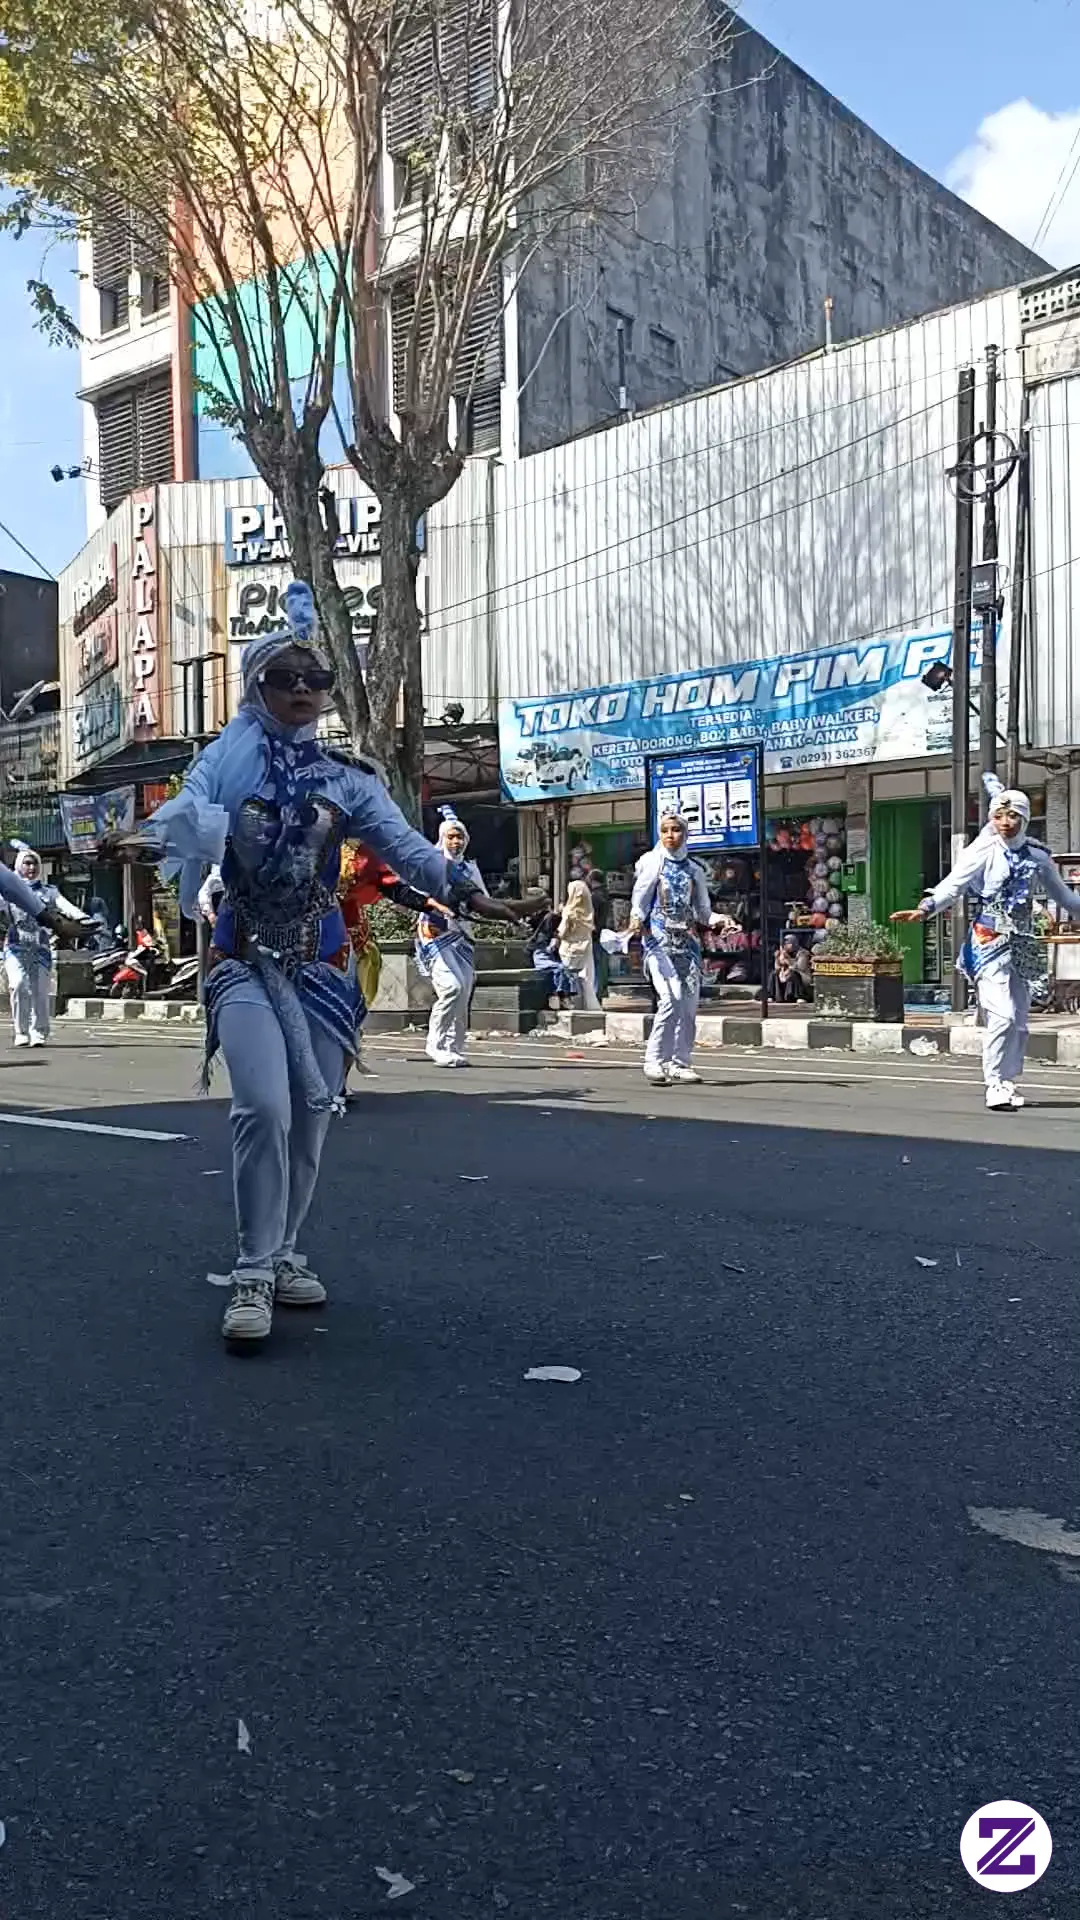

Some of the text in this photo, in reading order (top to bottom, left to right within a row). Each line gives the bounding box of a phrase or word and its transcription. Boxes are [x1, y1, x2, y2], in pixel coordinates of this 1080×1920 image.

[132, 502, 157, 727] PALAPA
[515, 689, 631, 736] TOKO
[642, 669, 760, 718] HOM
[772, 646, 888, 697] PIM
[593, 740, 640, 757] KERETA
[700, 728, 727, 744] BOX
[729, 724, 768, 740] BABY,
[771, 718, 809, 735] BABY
[811, 707, 881, 730] WALKER,
[610, 755, 645, 769] MOTO
[796, 750, 832, 767] (0293)
